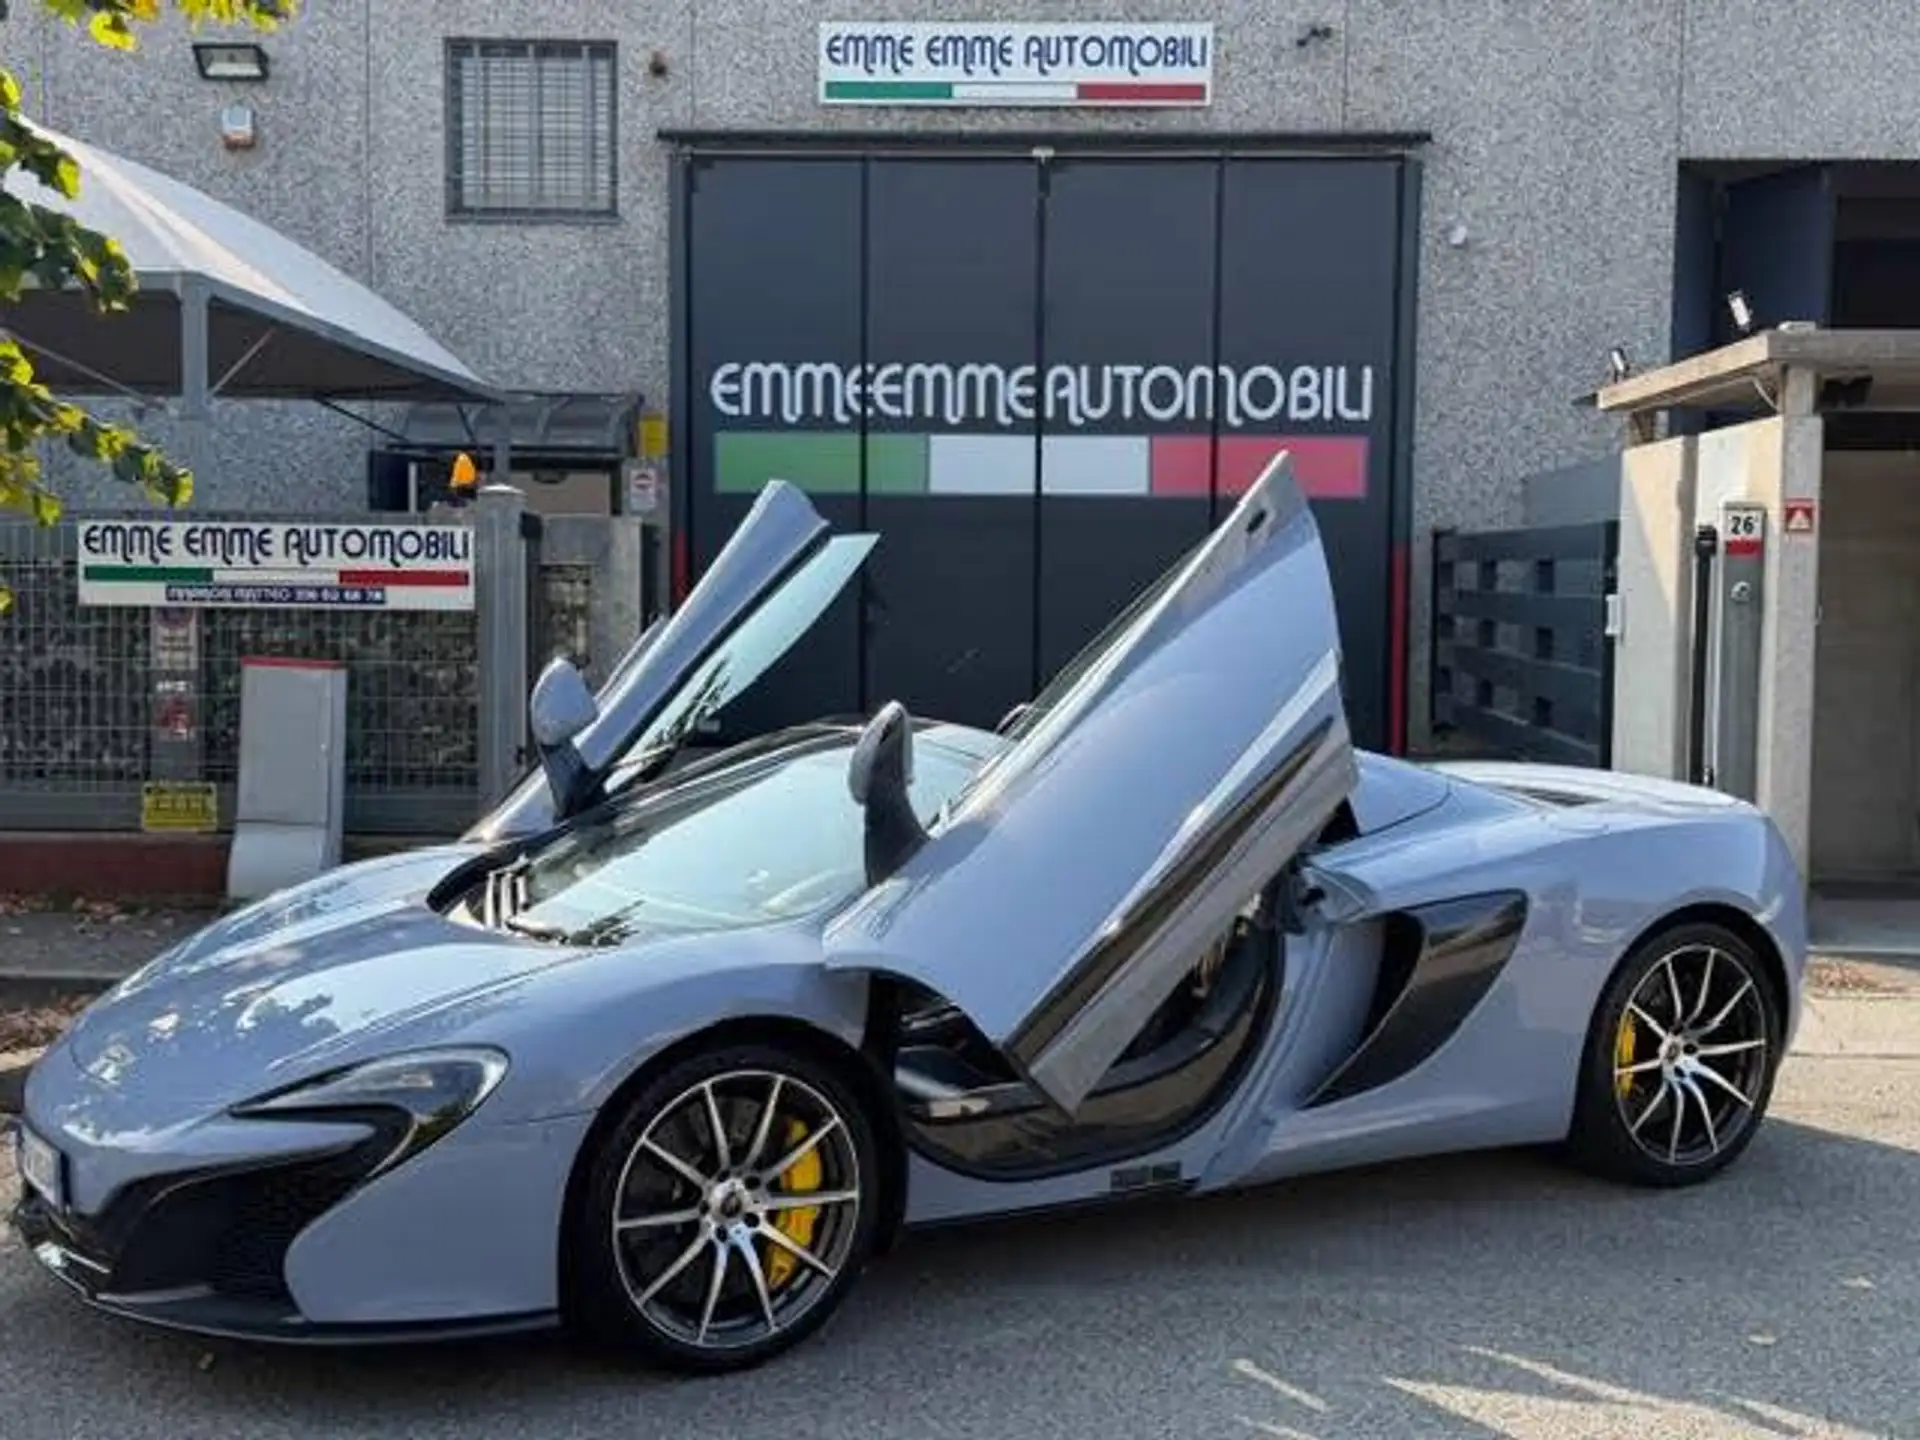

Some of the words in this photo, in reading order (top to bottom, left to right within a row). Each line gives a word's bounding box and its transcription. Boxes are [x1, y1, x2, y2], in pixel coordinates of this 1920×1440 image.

[826, 35, 914, 75] EMME
[925, 35, 1012, 76] EMME
[1023, 35, 1207, 76] AUTOMOBILI
[84, 525, 171, 564] EMME
[183, 526, 273, 566] EMME
[283, 528, 470, 567] AUTOMOBILI
